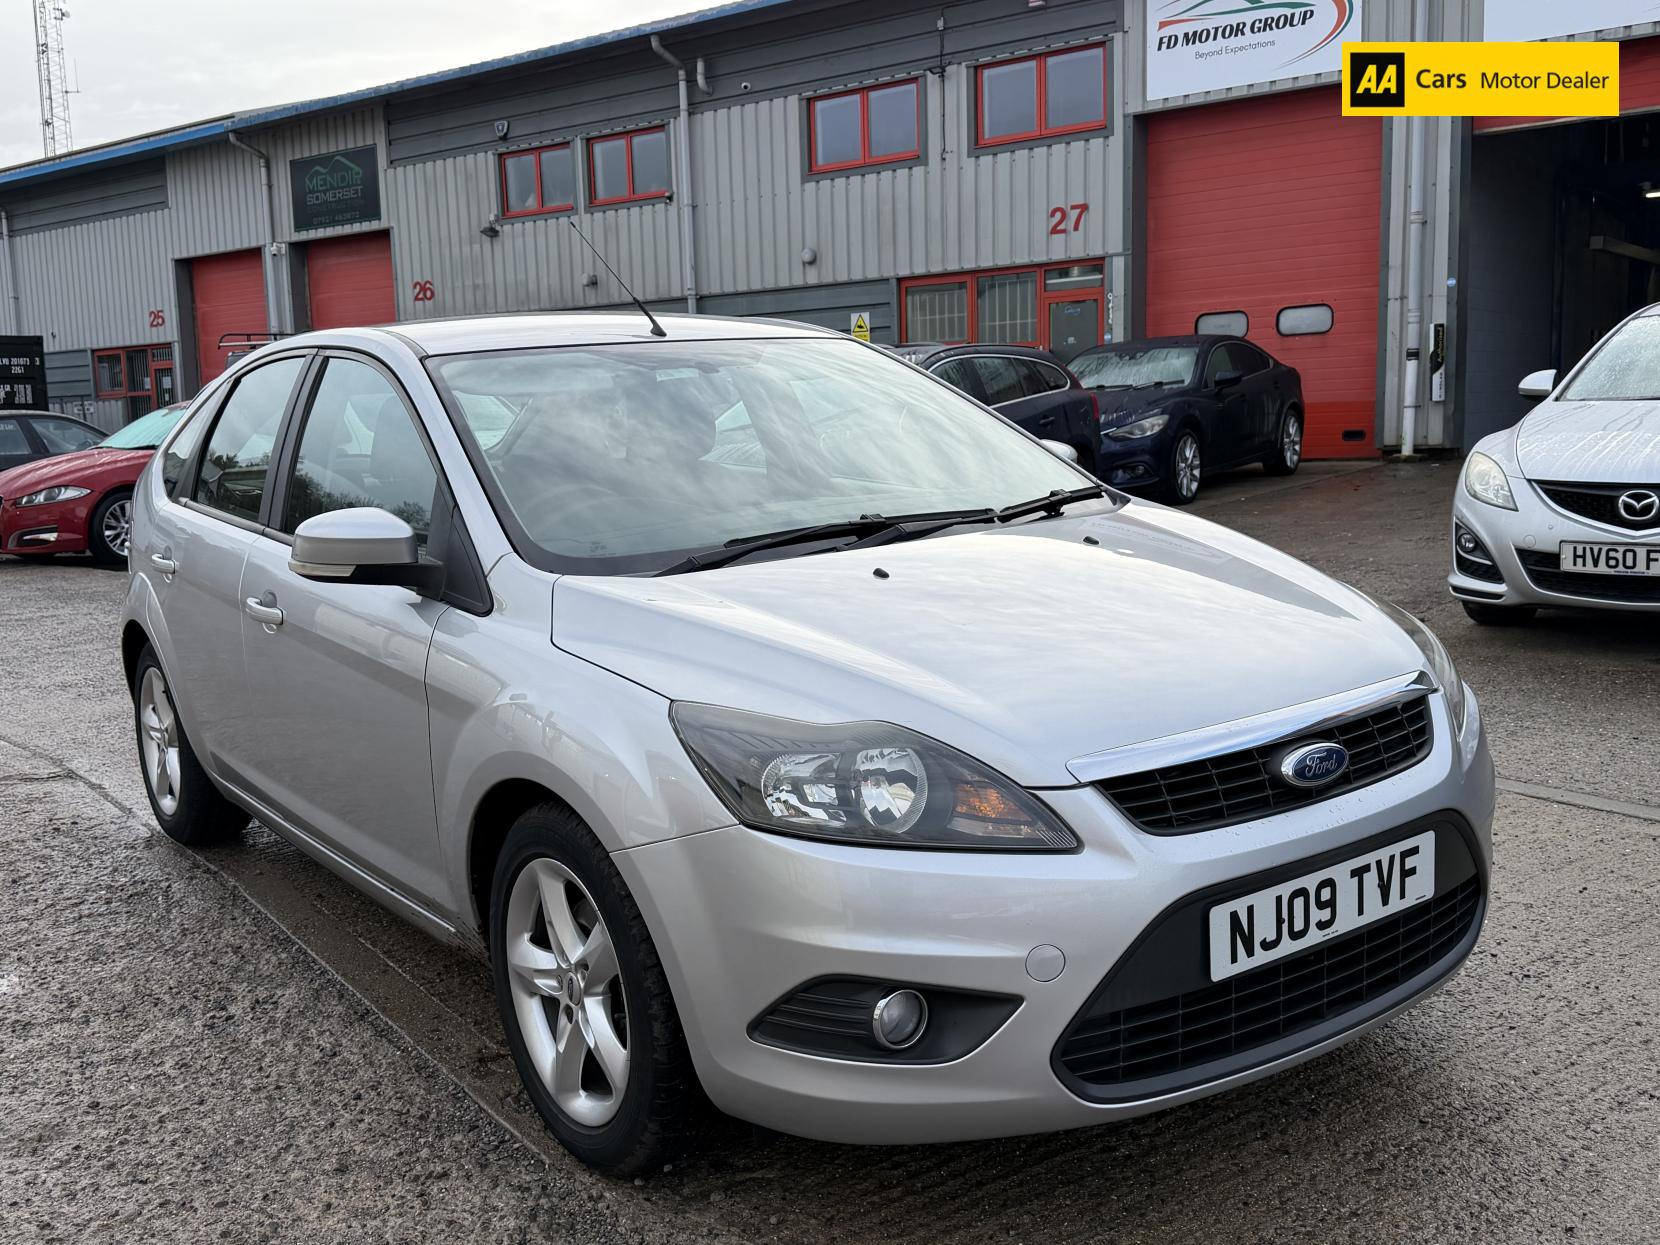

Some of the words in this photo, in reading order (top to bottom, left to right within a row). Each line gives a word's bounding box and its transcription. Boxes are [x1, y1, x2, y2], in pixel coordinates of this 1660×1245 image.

[1157, 34, 1179, 51] FD
[1181, 21, 1247, 47] MOTOR
[1250, 9, 1315, 34] GROUP
[1195, 47, 1223, 60] Beyond
[1225, 39, 1276, 55] Expectations
[306, 185, 363, 205] SOMERSET
[1050, 203, 1089, 235] 27
[413, 280, 434, 301] 26
[149, 309, 165, 327] 25
[1573, 546, 1637, 569] HV60
[1646, 549, 1660, 570] F
[1305, 751, 1338, 777] Ford
[1229, 877, 1337, 965] NJ09
[1350, 845, 1420, 917] TVF
